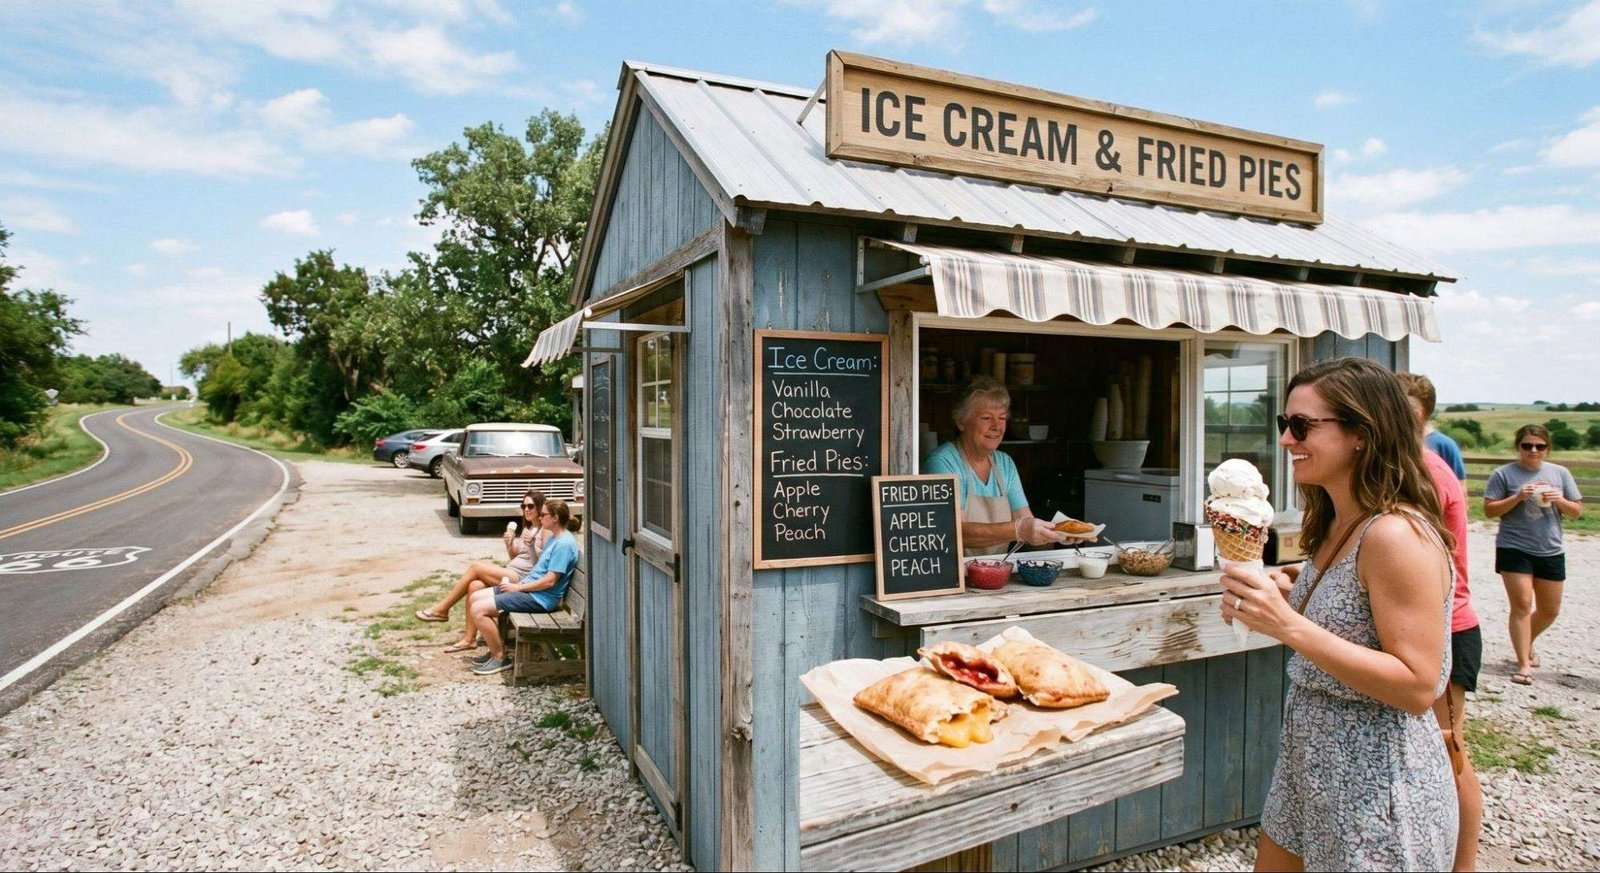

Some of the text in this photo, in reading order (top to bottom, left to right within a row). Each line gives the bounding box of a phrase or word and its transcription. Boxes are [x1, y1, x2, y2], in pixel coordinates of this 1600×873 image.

[861, 87, 1302, 201] ICE CREAM & FRIED PIES
[768, 346, 878, 371] Ice Cream:
[772, 379, 831, 399] Vanilla
[771, 401, 853, 419] Chocolate
[772, 422, 865, 448] Strawberry
[770, 448, 870, 473] Fried Pies:
[773, 481, 821, 504] Apple
[881, 483, 954, 502] FRIED PIES:
[772, 503, 830, 525] Cherry
[889, 511, 937, 531] APPLE
[775, 523, 826, 542] Peach
[888, 533, 950, 554] CHERRY,
[0, 555, 102, 571] 66
[891, 557, 942, 577] PEACH
